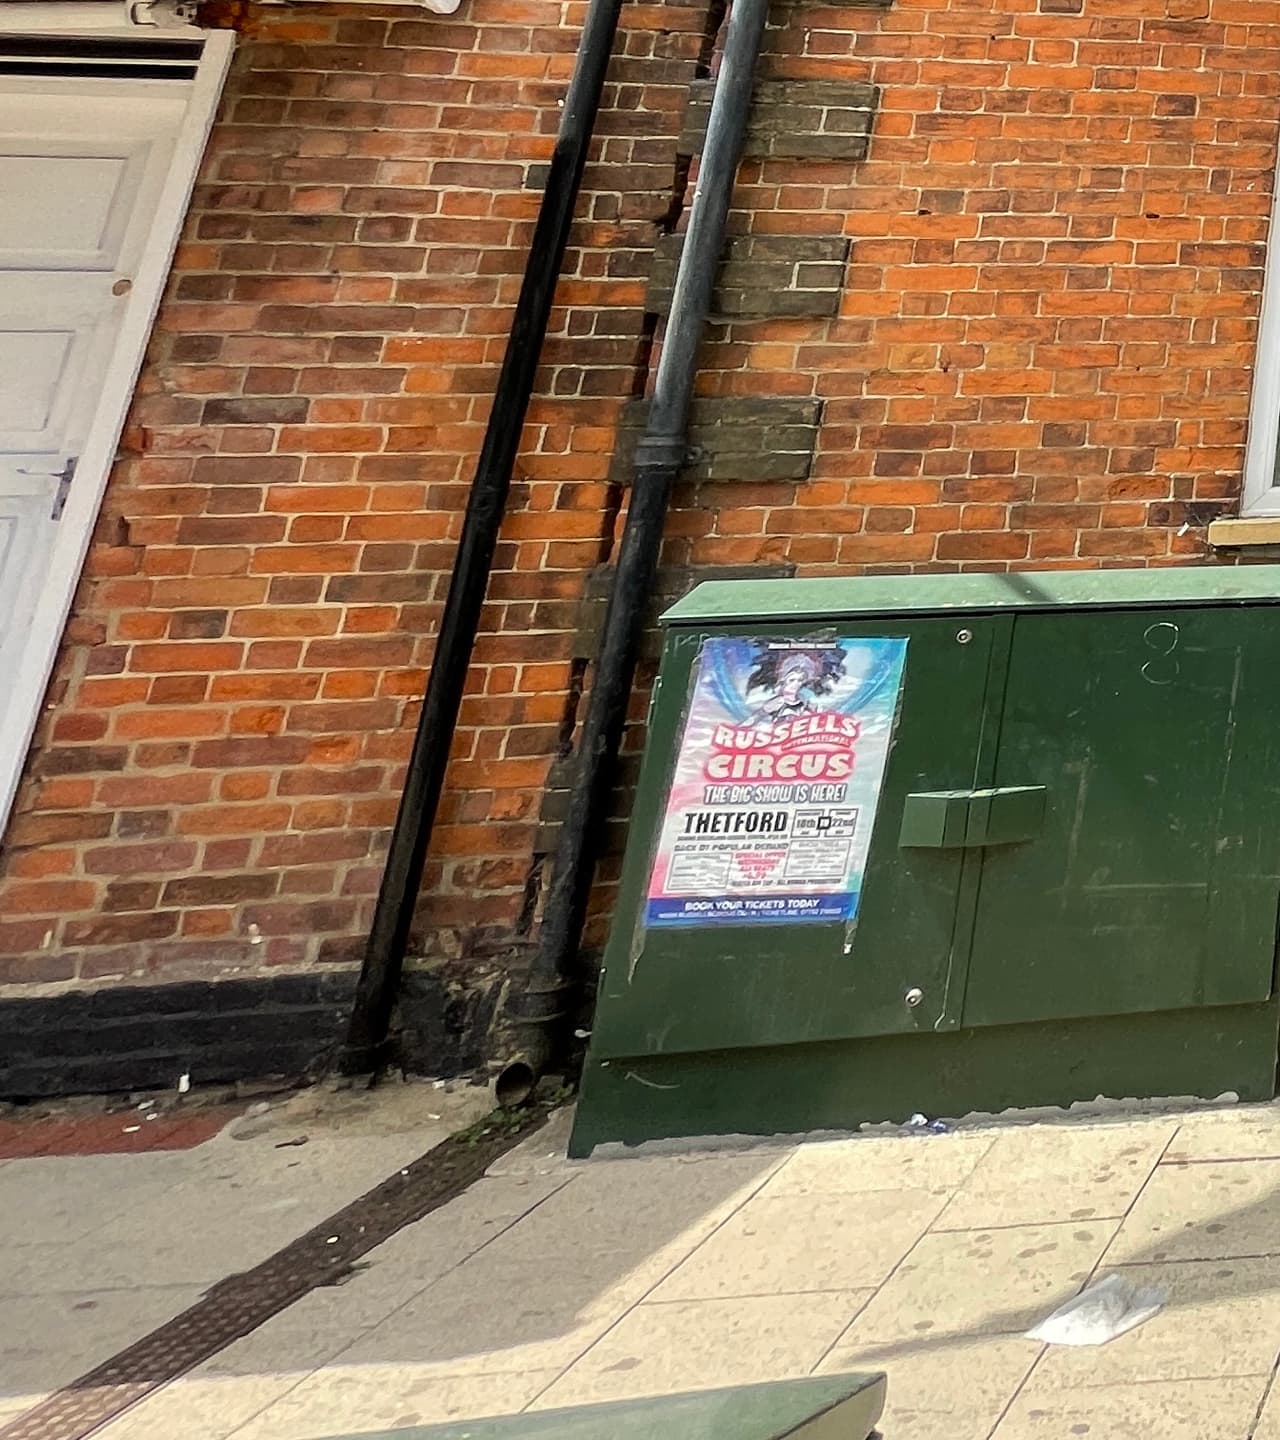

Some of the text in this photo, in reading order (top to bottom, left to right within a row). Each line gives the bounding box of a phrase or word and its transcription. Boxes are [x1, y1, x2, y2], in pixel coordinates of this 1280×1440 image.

[714, 713, 861, 749] RUSSELLS
[707, 753, 851, 778] CIRCUS
[704, 783, 847, 803] THE BIG SHOW IS HERE!
[684, 811, 789, 834] THETFORD
[685, 898, 820, 911] BOOK YOUR TICKETS TODAY
